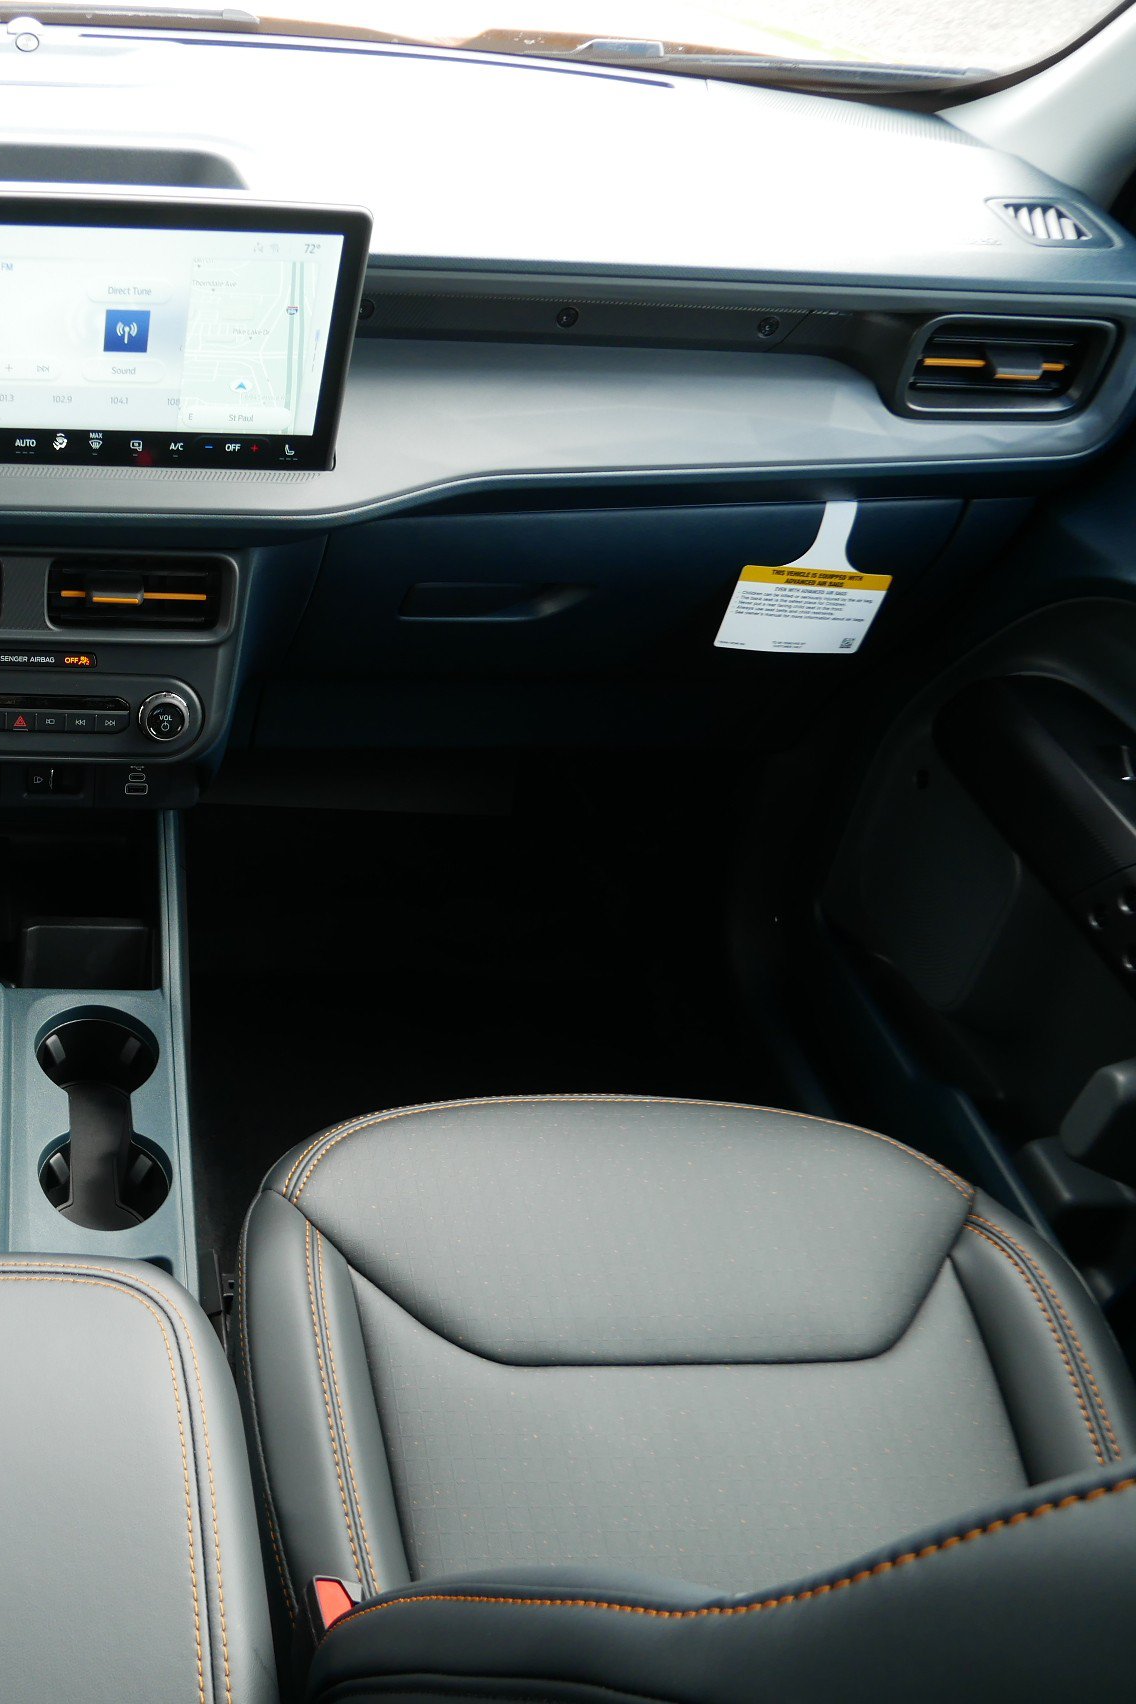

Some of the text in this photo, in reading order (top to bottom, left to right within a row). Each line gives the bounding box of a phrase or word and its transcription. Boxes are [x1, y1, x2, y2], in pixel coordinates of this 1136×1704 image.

[304, 243, 321, 254] 72°
[1, 263, 14, 271] FM
[108, 286, 152, 296] Direct Tune
[111, 367, 136, 376] Sound
[52, 395, 73, 403] 102.9
[110, 397, 129, 405] 104.1
[188, 413, 193, 421] E
[228, 414, 237, 422] St
[15, 439, 36, 447] AUTO
[169, 442, 184, 451] A/C
[225, 443, 241, 452] OFF
[784, 578, 815, 586] ADVANCED
[29, 655, 55, 663] AIRBAG
[64, 656, 78, 664] OFF
